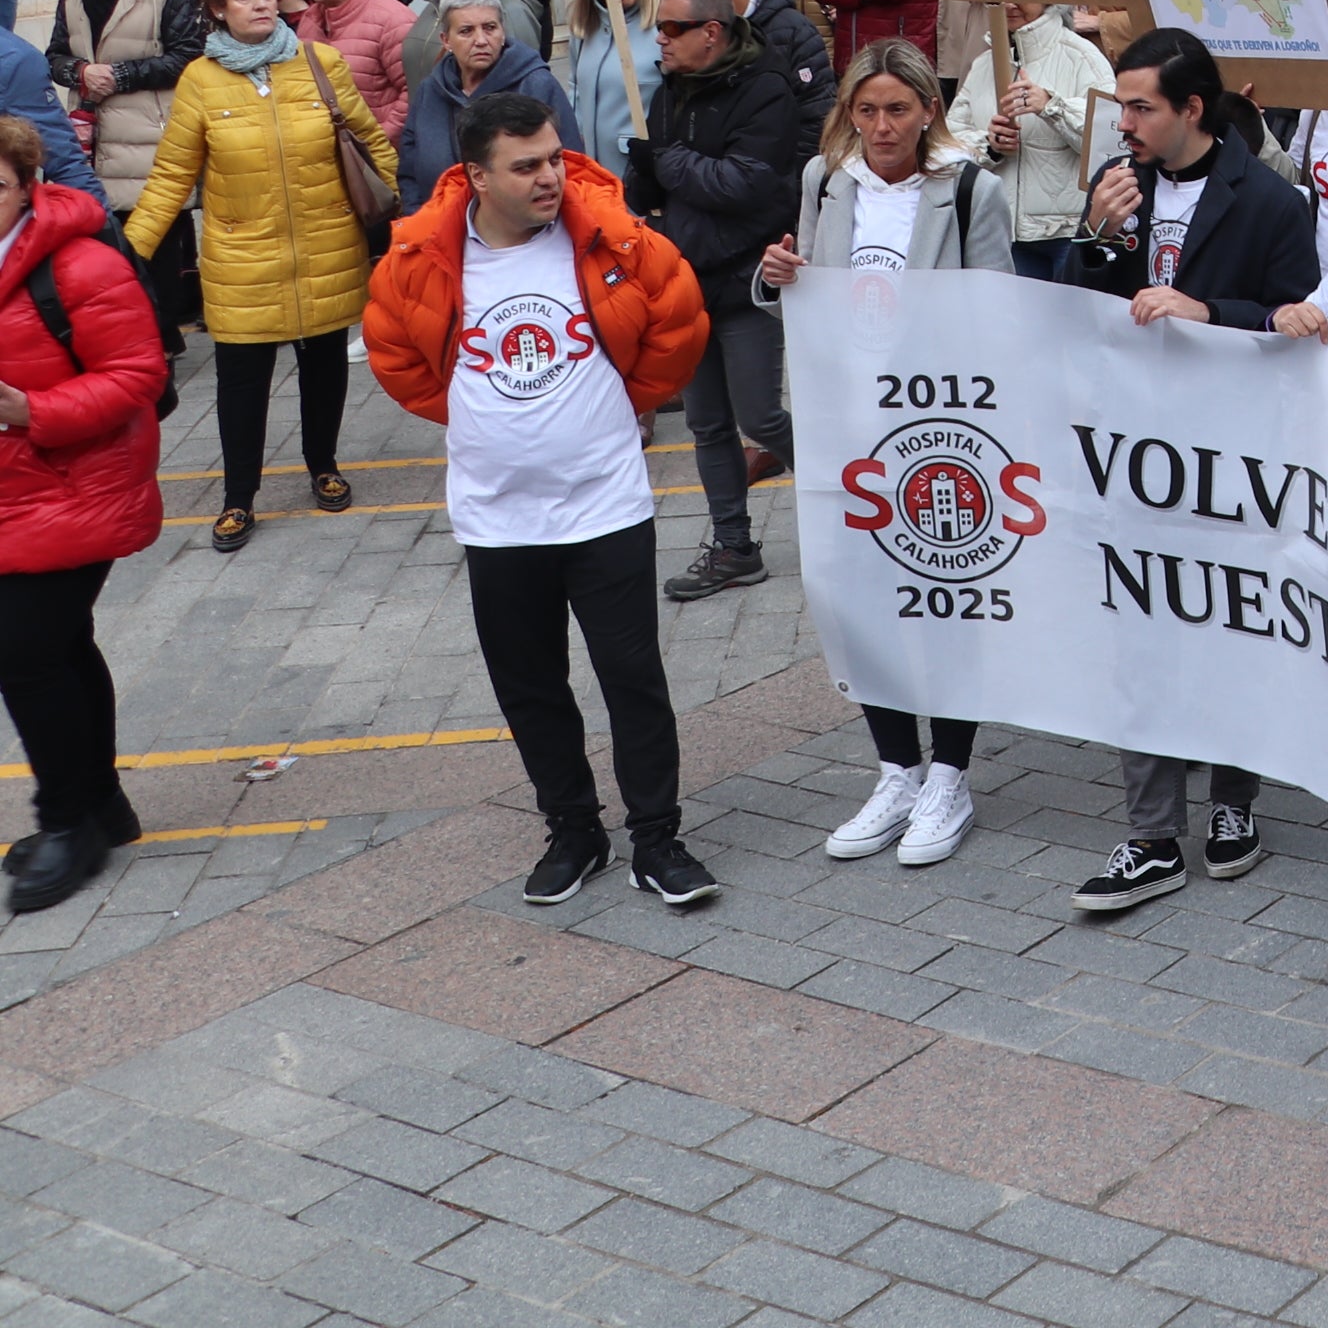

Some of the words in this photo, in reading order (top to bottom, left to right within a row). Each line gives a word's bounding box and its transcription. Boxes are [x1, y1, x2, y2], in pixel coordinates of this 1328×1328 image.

[1244, 41, 1273, 51] DERIVEN
[1282, 39, 1320, 52] LOGROÑO!
[493, 302, 552, 324] HOSPITAL
[495, 363, 565, 391] CALAHORRA
[876, 374, 998, 410] 2012
[895, 432, 983, 460] HOSPITAL
[894, 533, 1004, 570] CALAHORRA
[896, 586, 1014, 622] 2025
